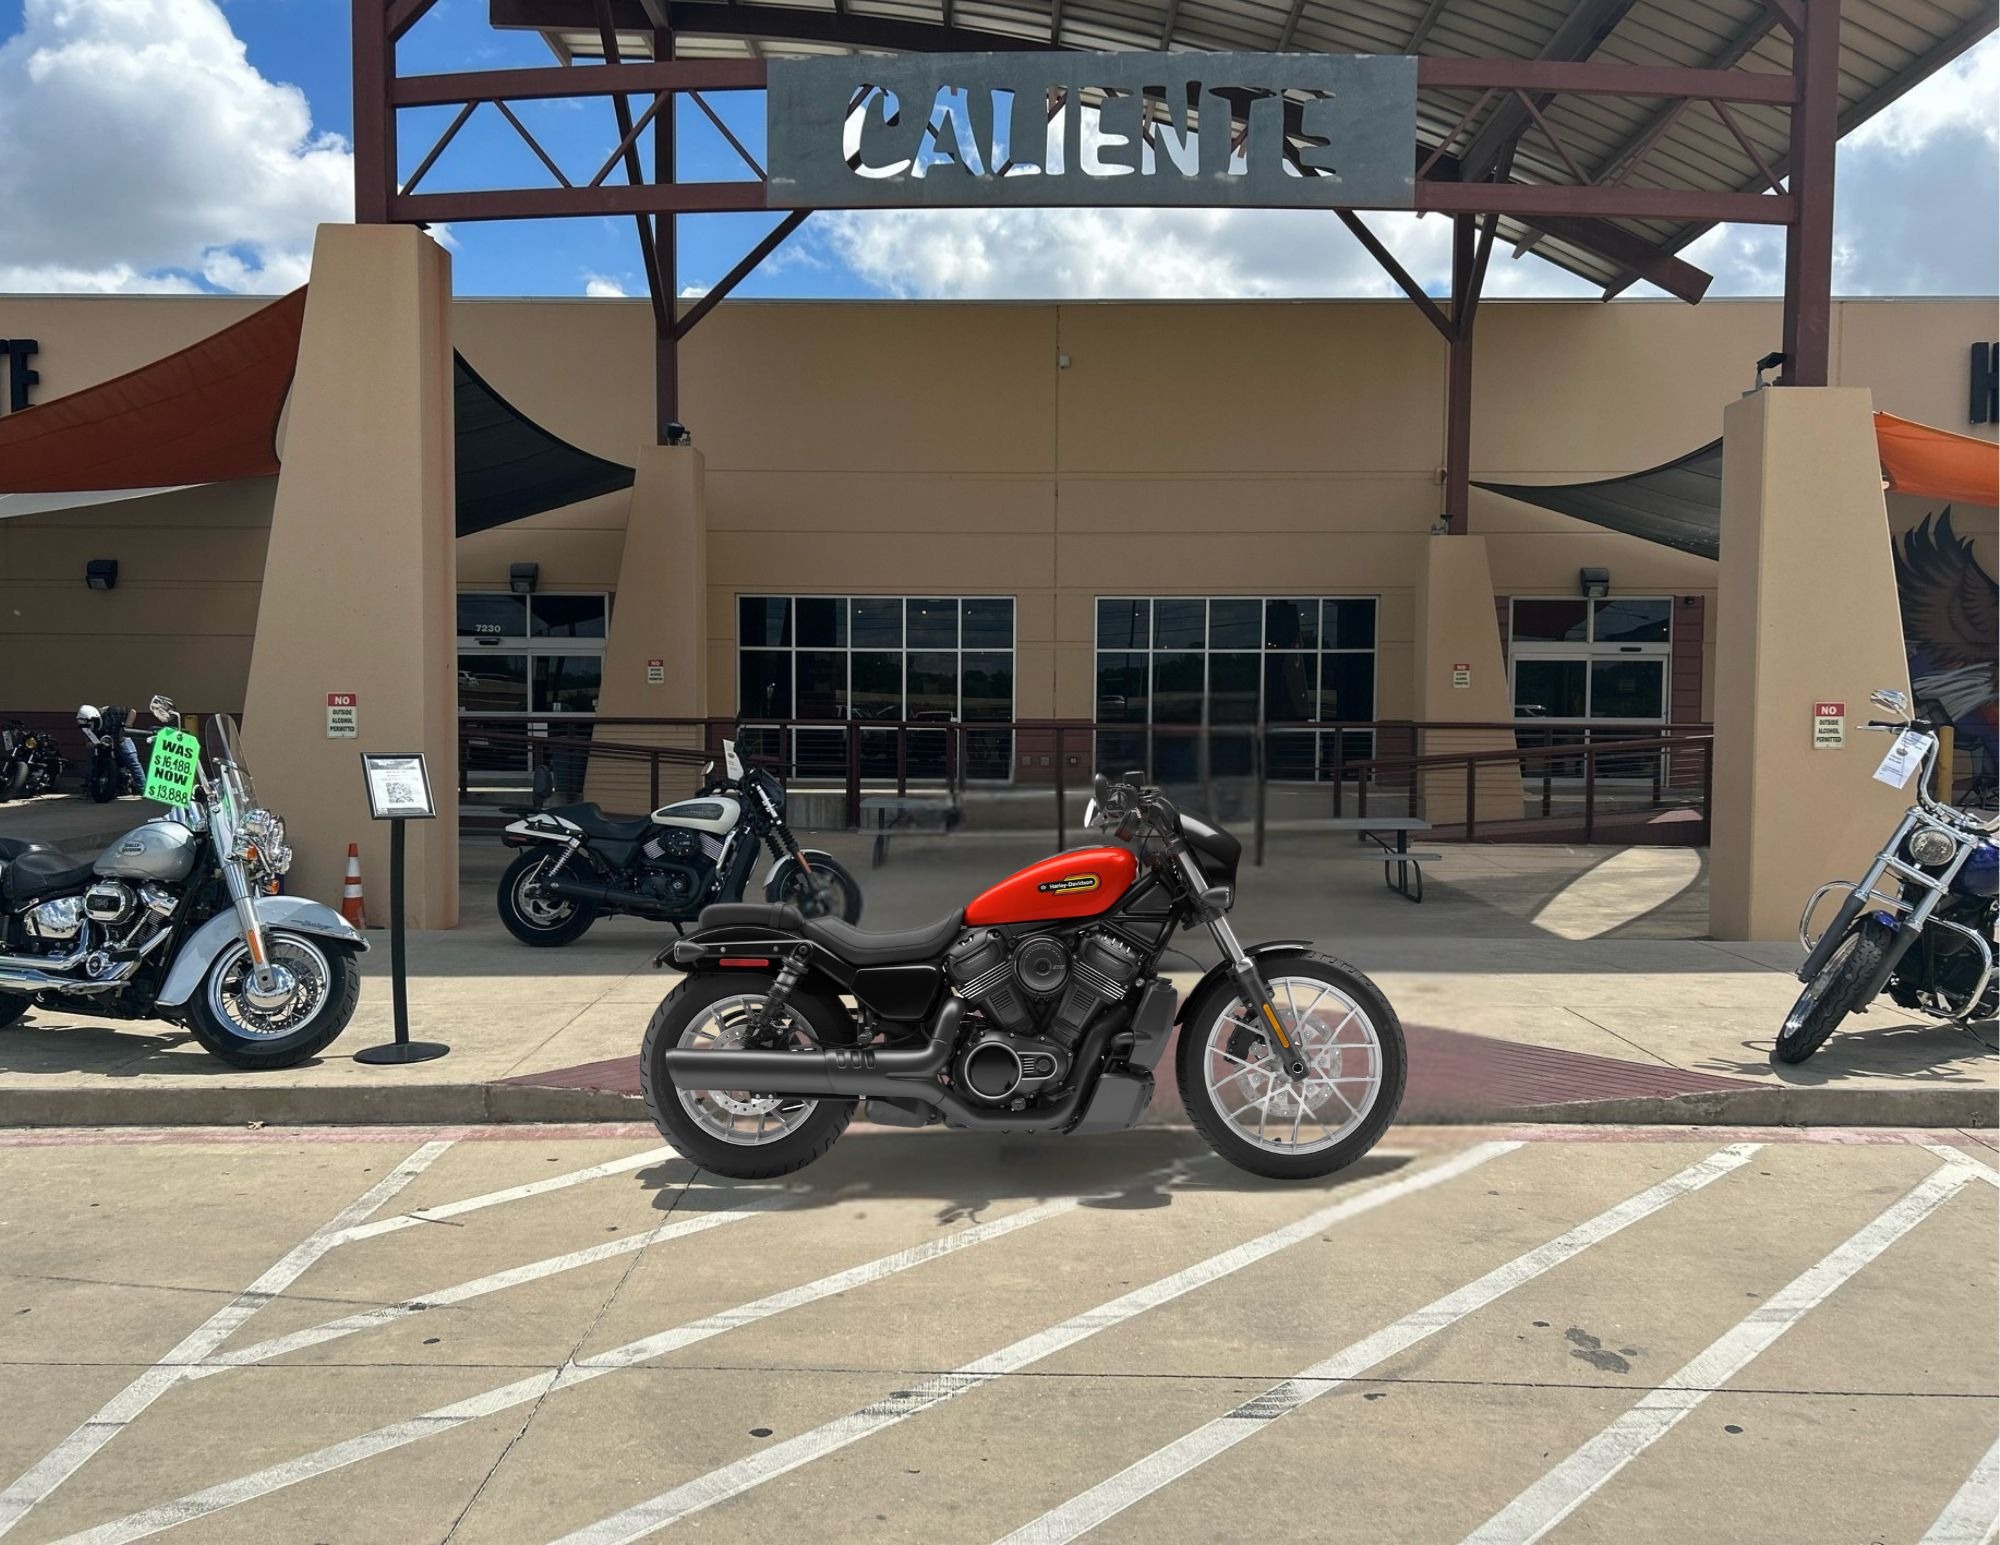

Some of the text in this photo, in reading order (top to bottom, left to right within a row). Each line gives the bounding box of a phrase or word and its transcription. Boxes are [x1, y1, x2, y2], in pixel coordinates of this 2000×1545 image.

[842, 81, 1337, 178] CALIENTE
[475, 624, 501, 633] 7230
[335, 696, 350, 705] NO
[1821, 706, 1837, 715] NO
[162, 740, 193, 759] WAS
[155, 767, 188, 786] NOW
[1049, 880, 1093, 889] Harley-Davidson
